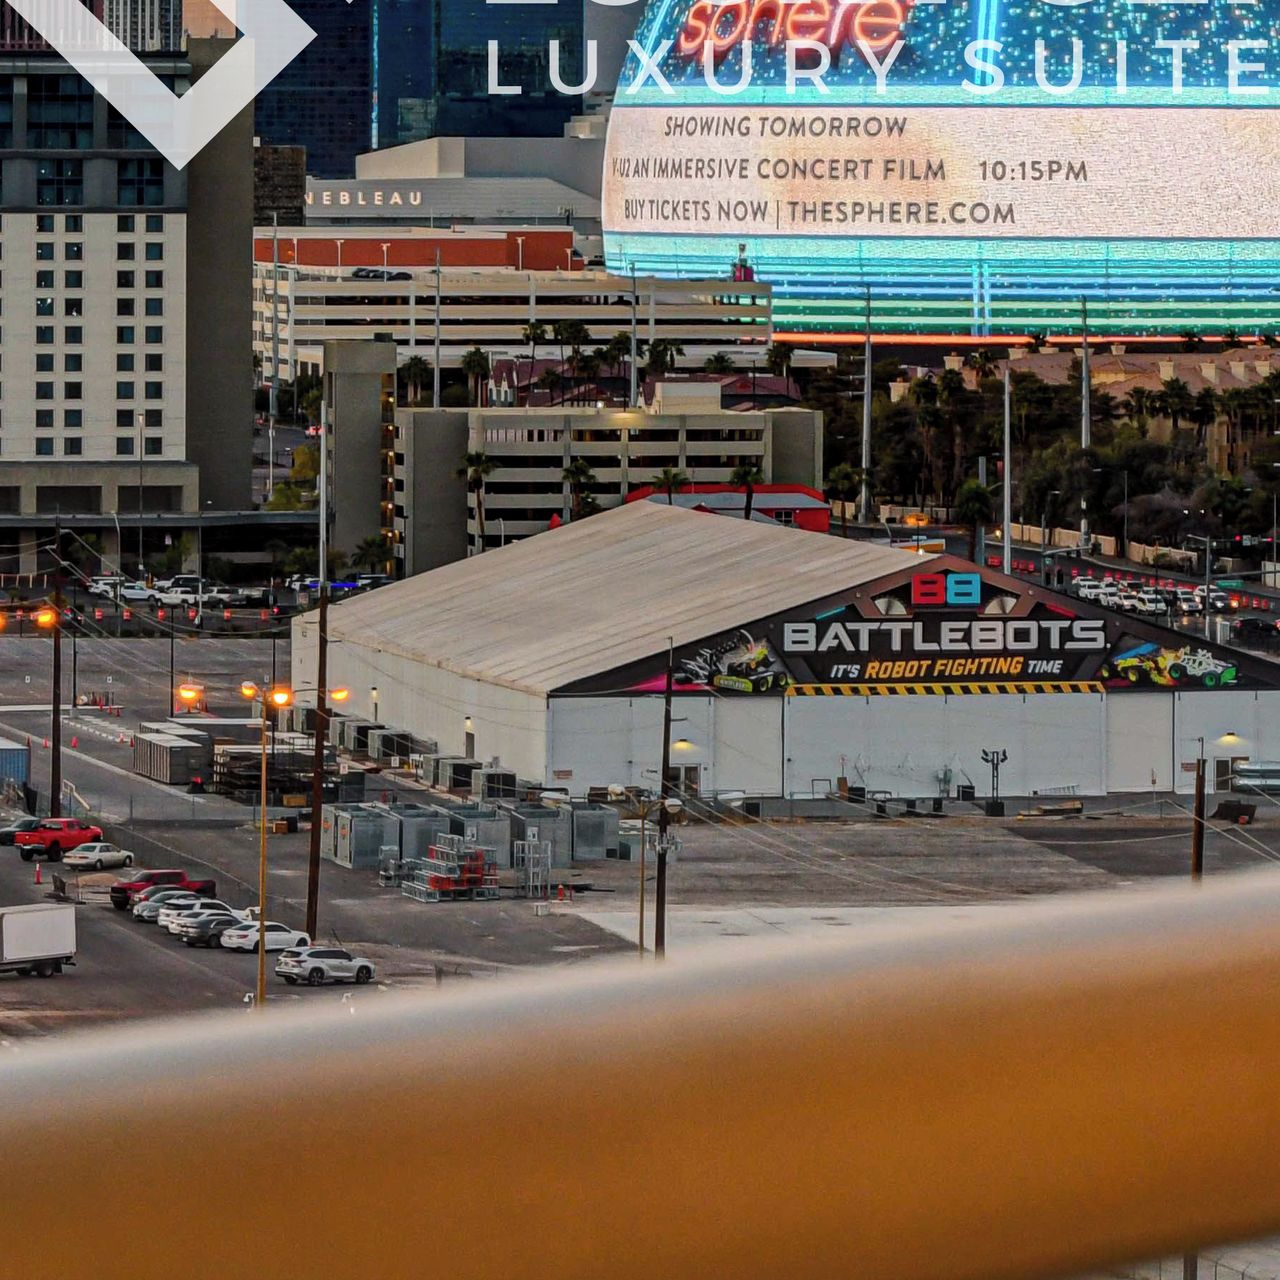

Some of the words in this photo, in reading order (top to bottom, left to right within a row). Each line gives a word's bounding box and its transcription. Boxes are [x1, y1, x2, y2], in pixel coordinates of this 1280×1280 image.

[664, 116, 751, 137] SHOWING
[759, 116, 907, 138] TOMORROW
[632, 158, 650, 178] AN
[653, 158, 750, 179] IMMERSIVE
[757, 158, 874, 180] CONCERT
[883, 159, 946, 181] FILM
[979, 160, 1088, 182] 10:15PM
[624, 199, 646, 220] BUY
[648, 199, 711, 221] TICKETS
[718, 200, 769, 222] NOW
[787, 201, 1016, 224] THESPHERE.COM
[830, 664, 859, 679] IT'S
[865, 658, 931, 679] ROBOT
[933, 656, 1024, 677] FIGHTING
[1027, 659, 1063, 675] TIME
